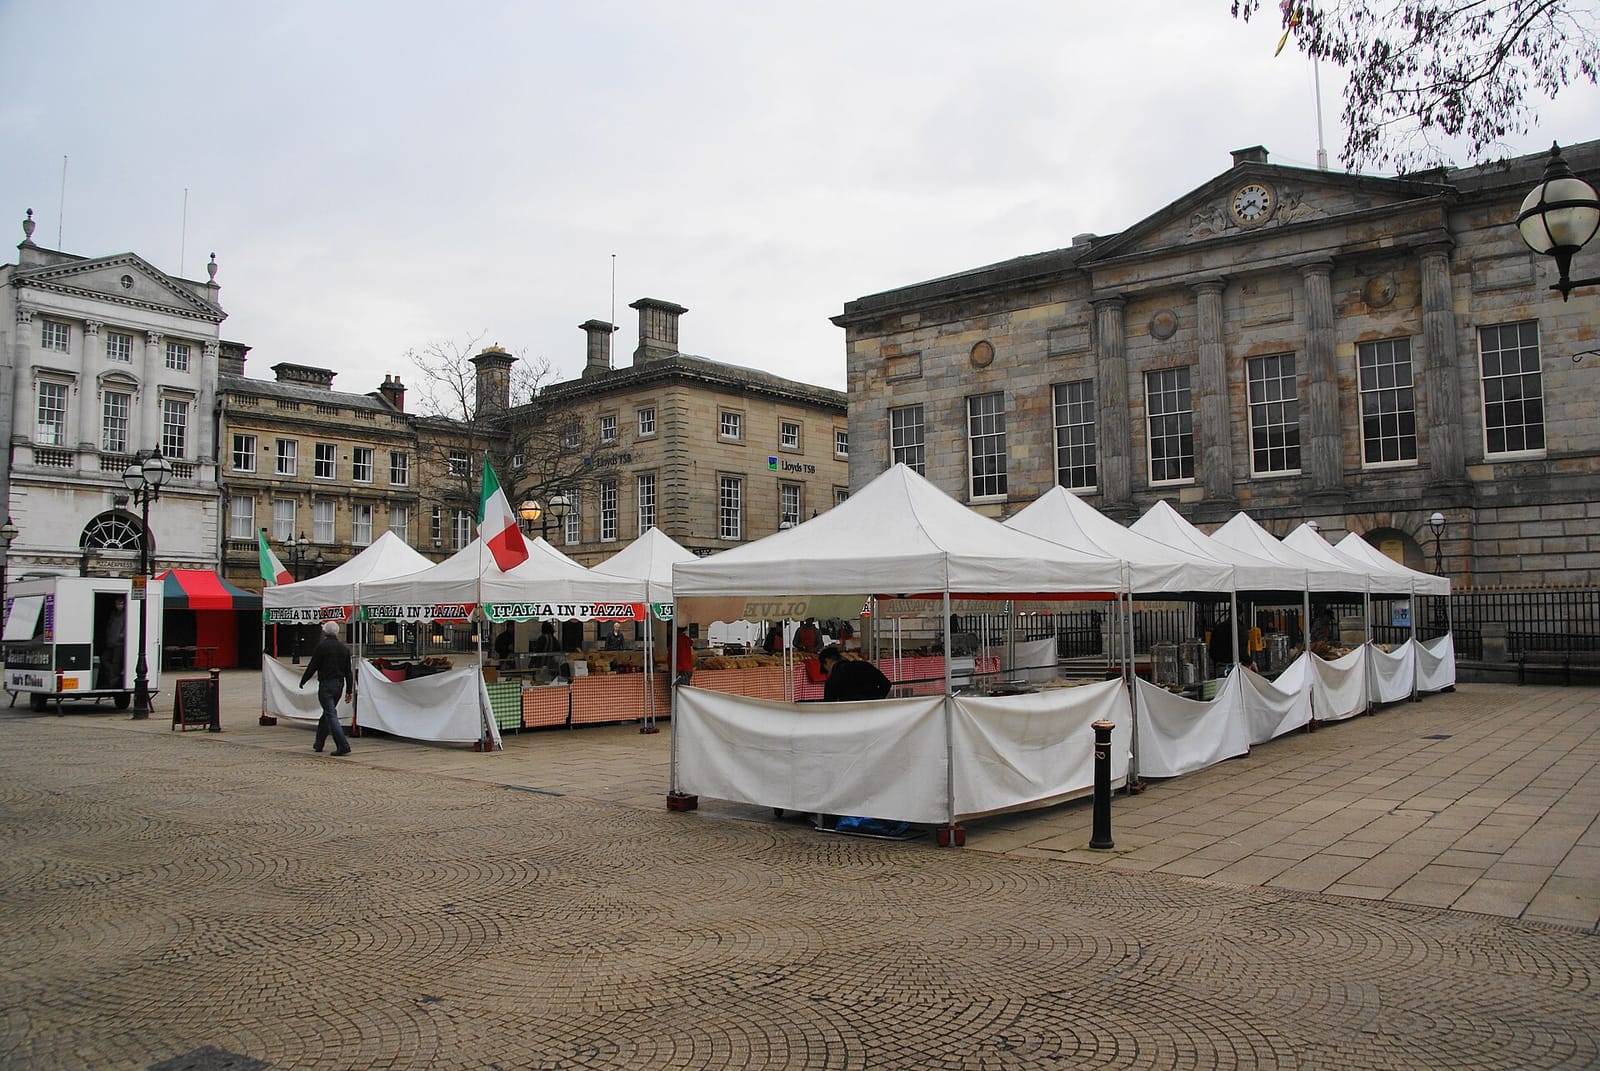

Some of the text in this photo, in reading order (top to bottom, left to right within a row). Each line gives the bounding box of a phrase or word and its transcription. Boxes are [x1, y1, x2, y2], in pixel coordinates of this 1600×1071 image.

[618, 452, 632, 464] TSB
[781, 460, 816, 474] Lloyds TSB
[270, 608, 345, 620] ITALIA IN PIAZZA
[367, 606, 469, 618] ITALIA IN PIAZZA
[493, 604, 634, 617] ITALIA IN PIAZZA
